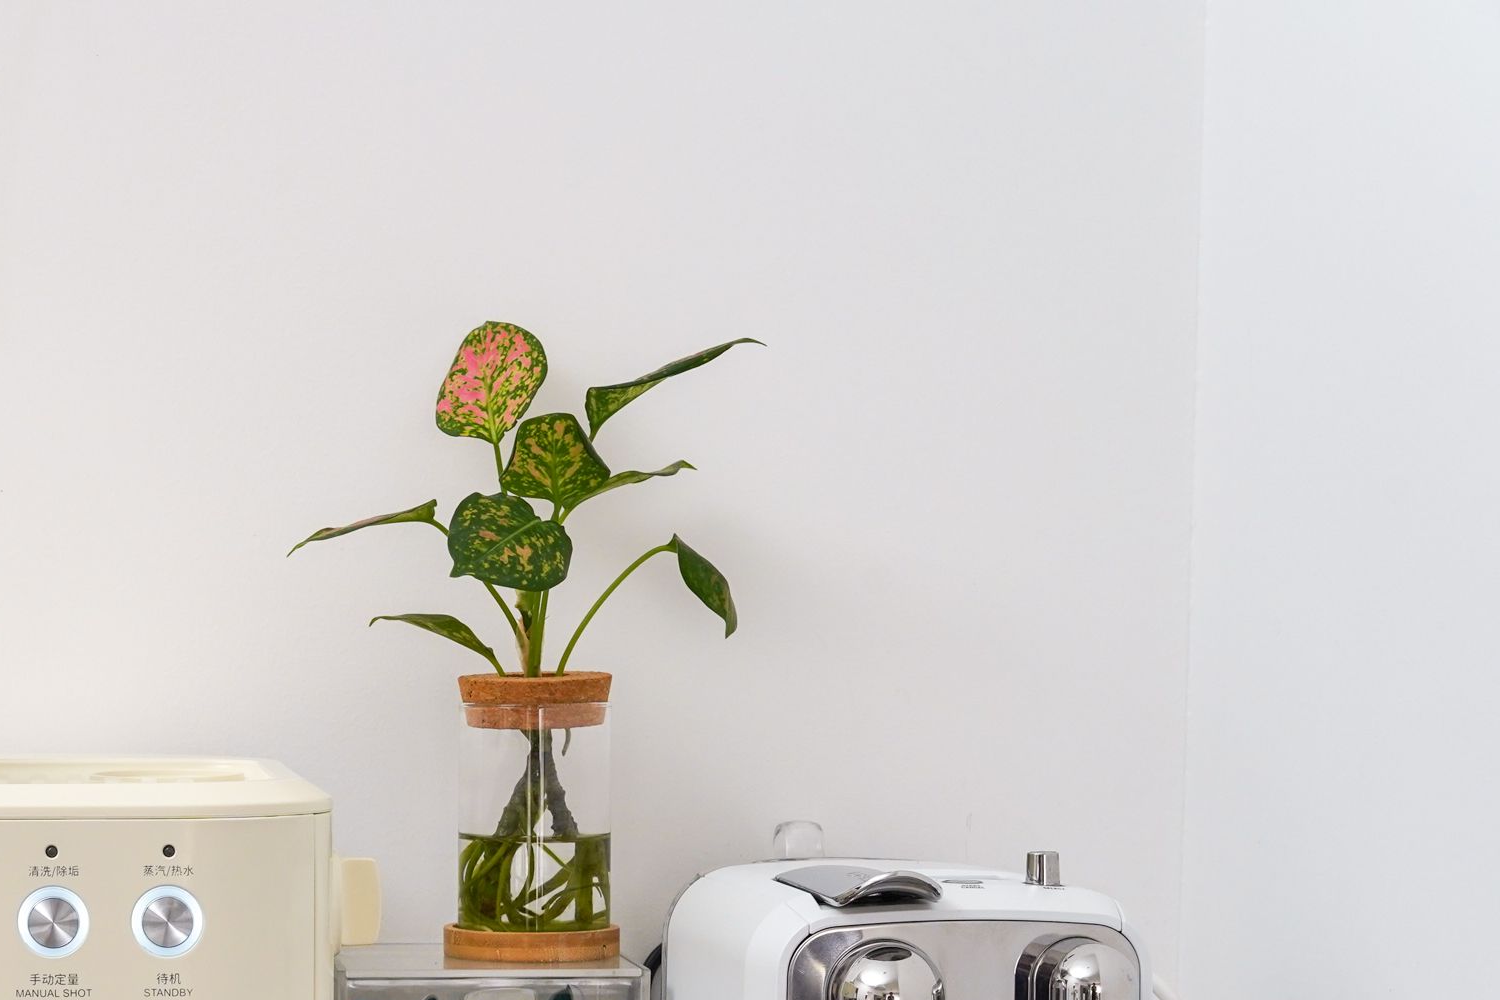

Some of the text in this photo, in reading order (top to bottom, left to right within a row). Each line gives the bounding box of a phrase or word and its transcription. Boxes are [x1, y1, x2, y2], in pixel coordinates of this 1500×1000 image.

[28, 865, 80, 877] 清洗/除垢
[143, 865, 194, 877] 蒸汽/热水
[29, 973, 79, 986] 手动定量
[156, 972, 182, 985] 待机
[15, 988, 93, 998] MANUAL SHOT
[143, 988, 194, 998] STANDBY
